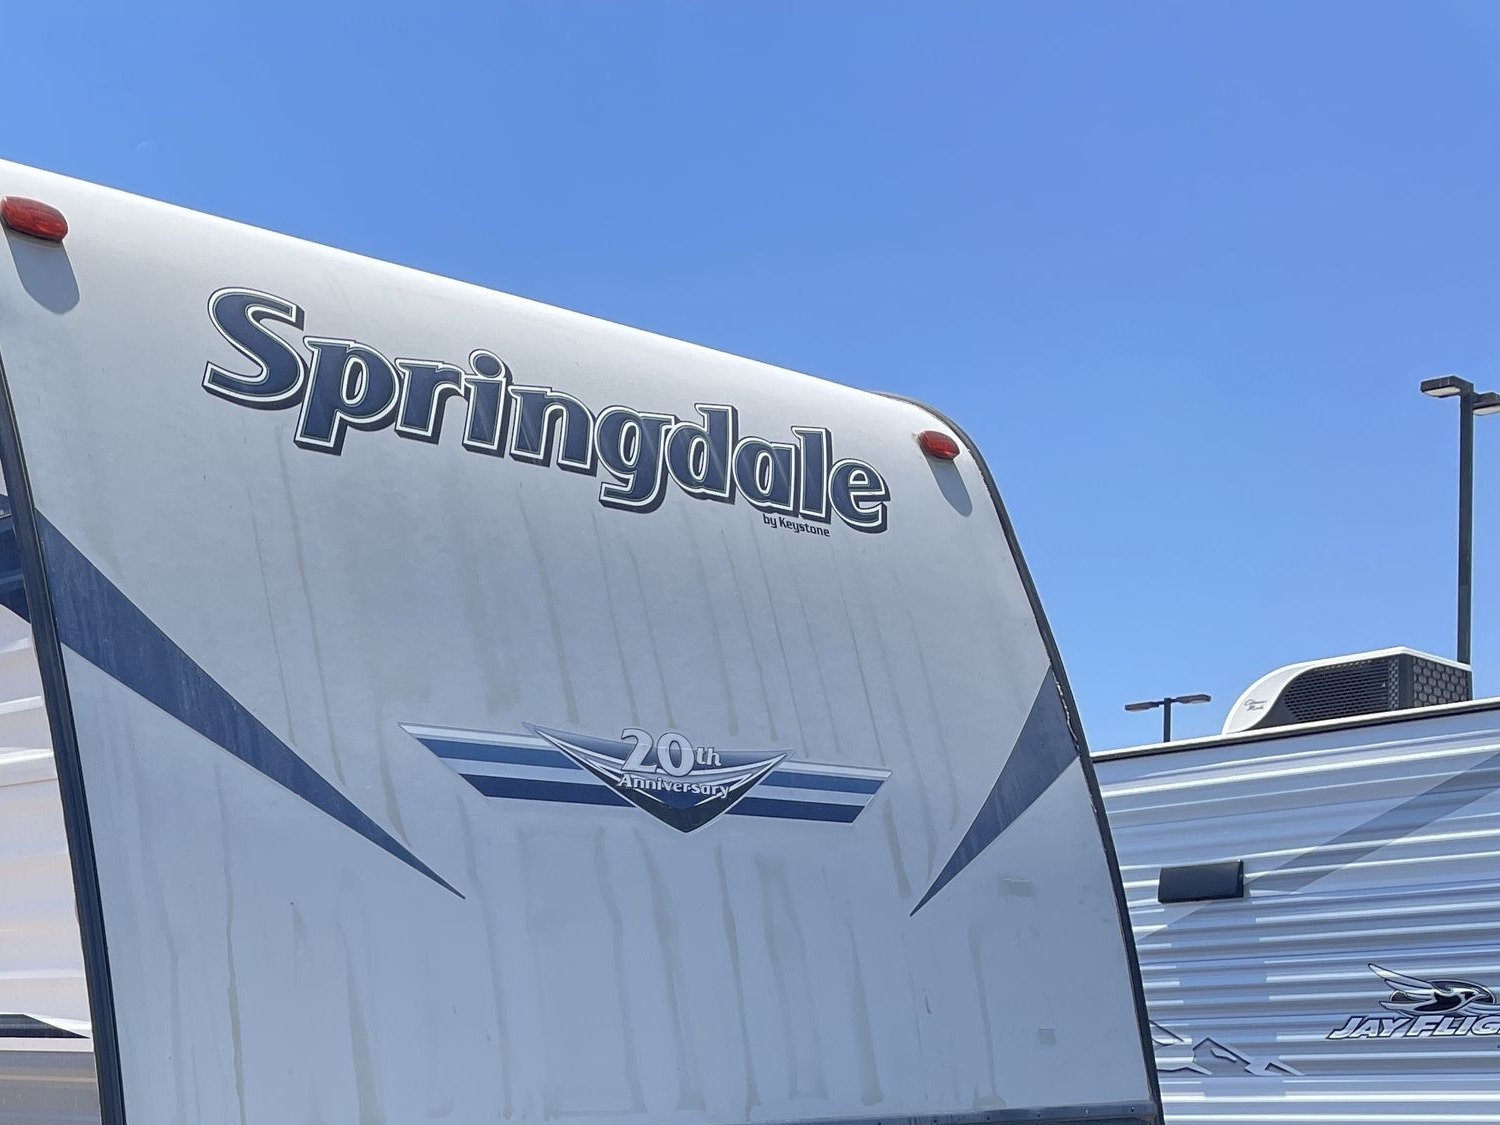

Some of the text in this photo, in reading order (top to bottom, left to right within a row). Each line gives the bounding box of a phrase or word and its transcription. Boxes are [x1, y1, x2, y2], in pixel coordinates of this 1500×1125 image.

[202, 287, 891, 533] Springdale
[762, 513, 831, 538] by Keystone
[620, 727, 722, 778] 20th
[618, 773, 730, 799] Anniversary
[1326, 1014, 1414, 1039] JAY
